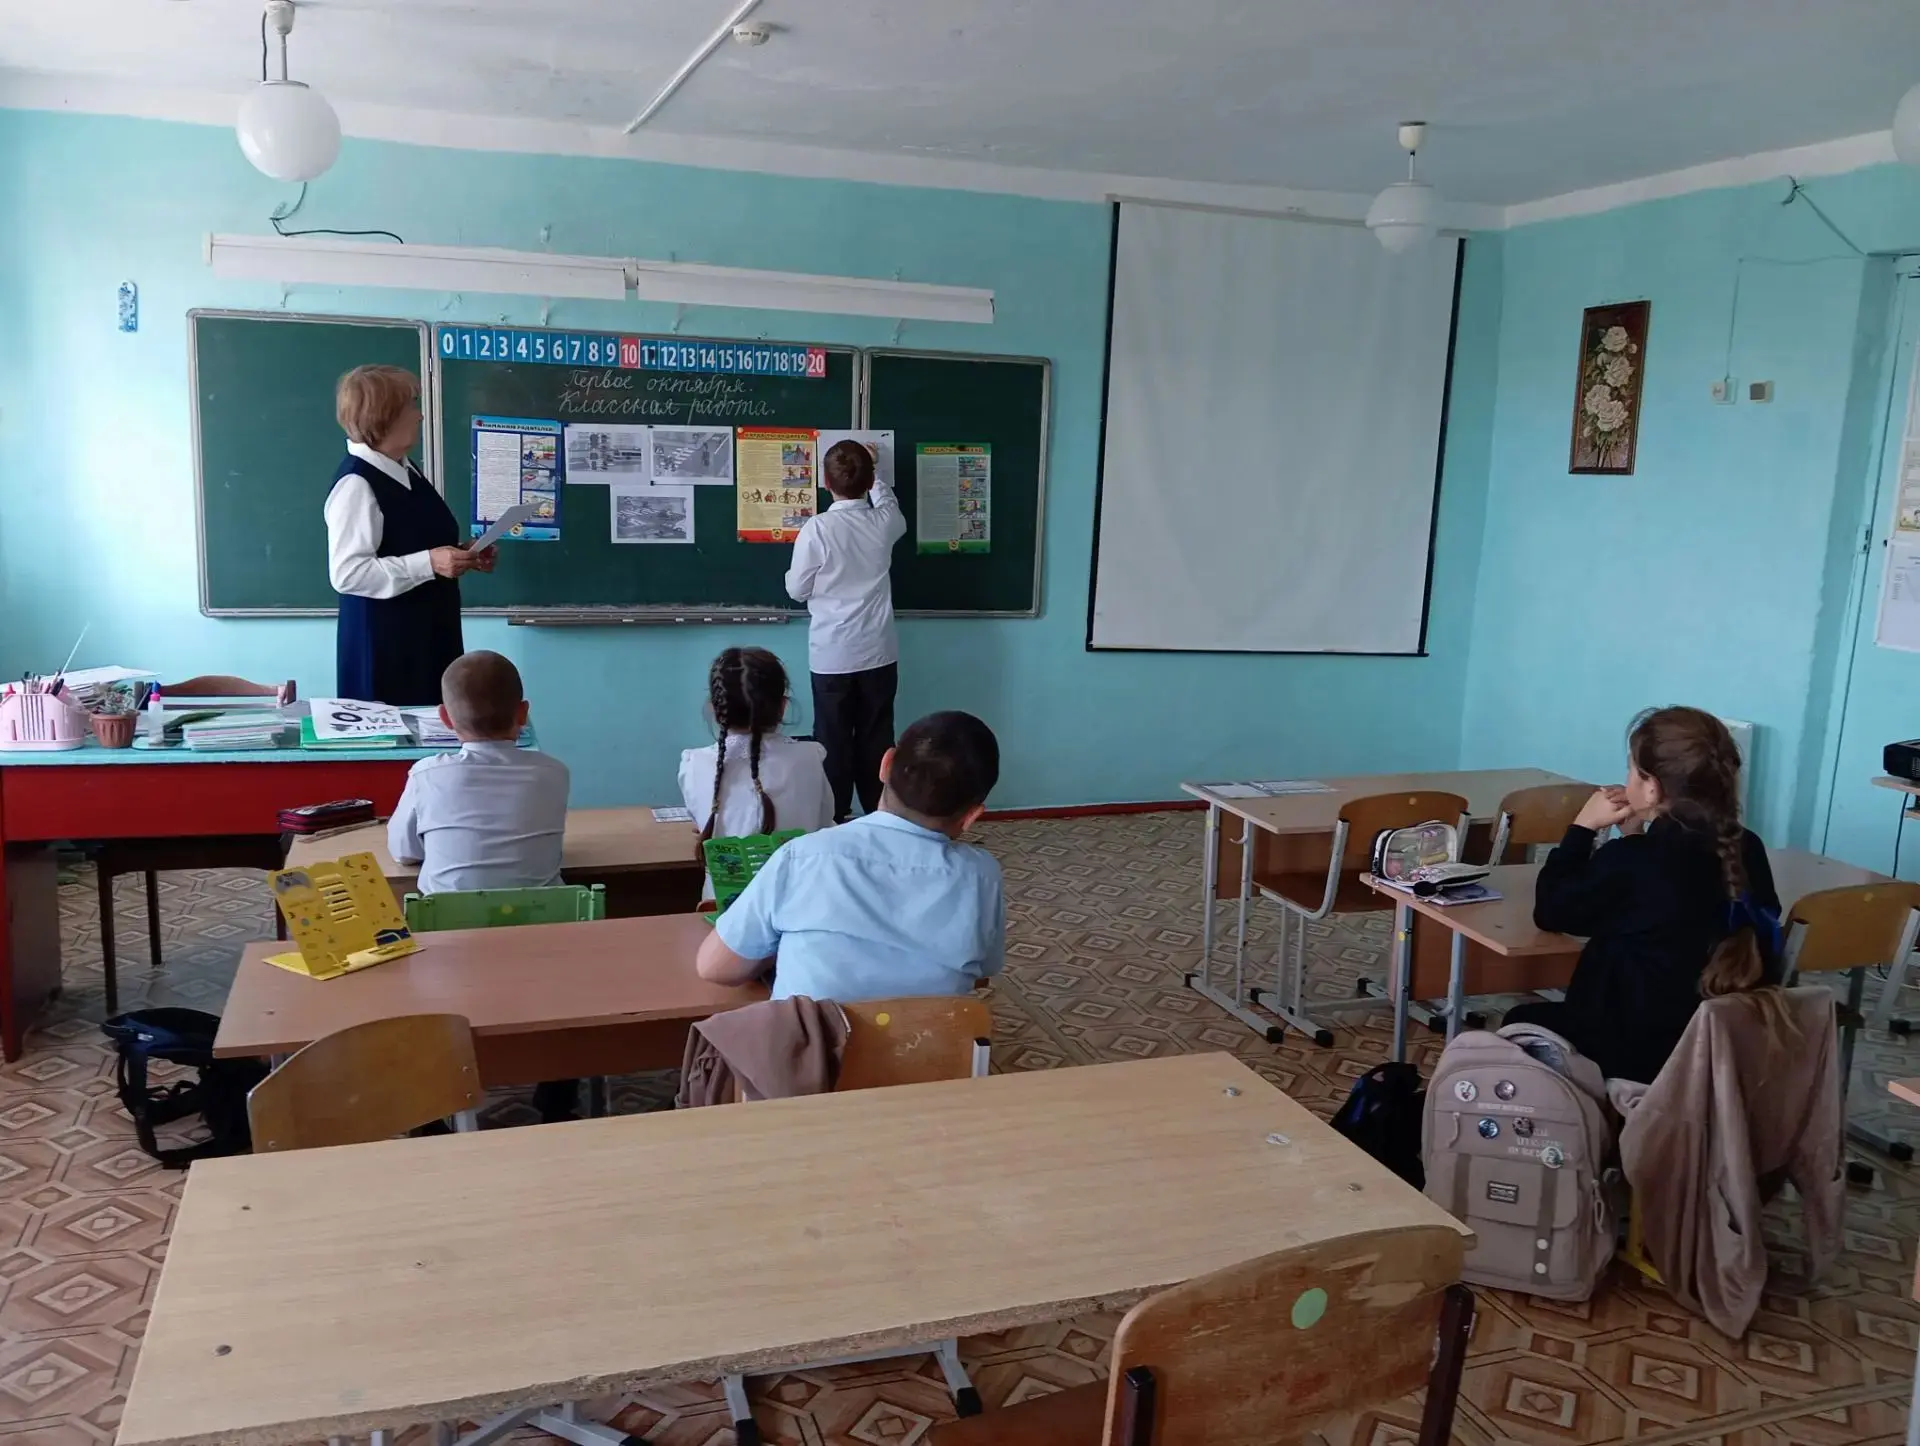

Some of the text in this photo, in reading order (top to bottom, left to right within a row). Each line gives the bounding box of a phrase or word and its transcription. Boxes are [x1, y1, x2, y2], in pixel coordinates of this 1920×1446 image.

[442, 333, 455, 354] 0
[462, 334, 471, 355] 1
[480, 336, 491, 356] 2
[499, 336, 508, 357] 3
[516, 337, 527, 358] 4
[535, 339, 545, 359] 5
[553, 340, 564, 360] 6
[571, 341, 581, 360] 7
[588, 342, 599, 361] 8
[606, 343, 616, 362] 9
[622, 344, 637, 364] 10
[660, 346, 676, 366] 12
[681, 348, 696, 367] 13
[700, 348, 715, 368] 14
[718, 349, 733, 369] 15
[736, 351, 752, 370] 16
[755, 352, 770, 371] 17
[774, 352, 788, 371] 18
[791, 353, 806, 372] 19
[808, 354, 825, 373] 20
[564, 369, 634, 395] Первое
[558, 391, 681, 416] Классная
